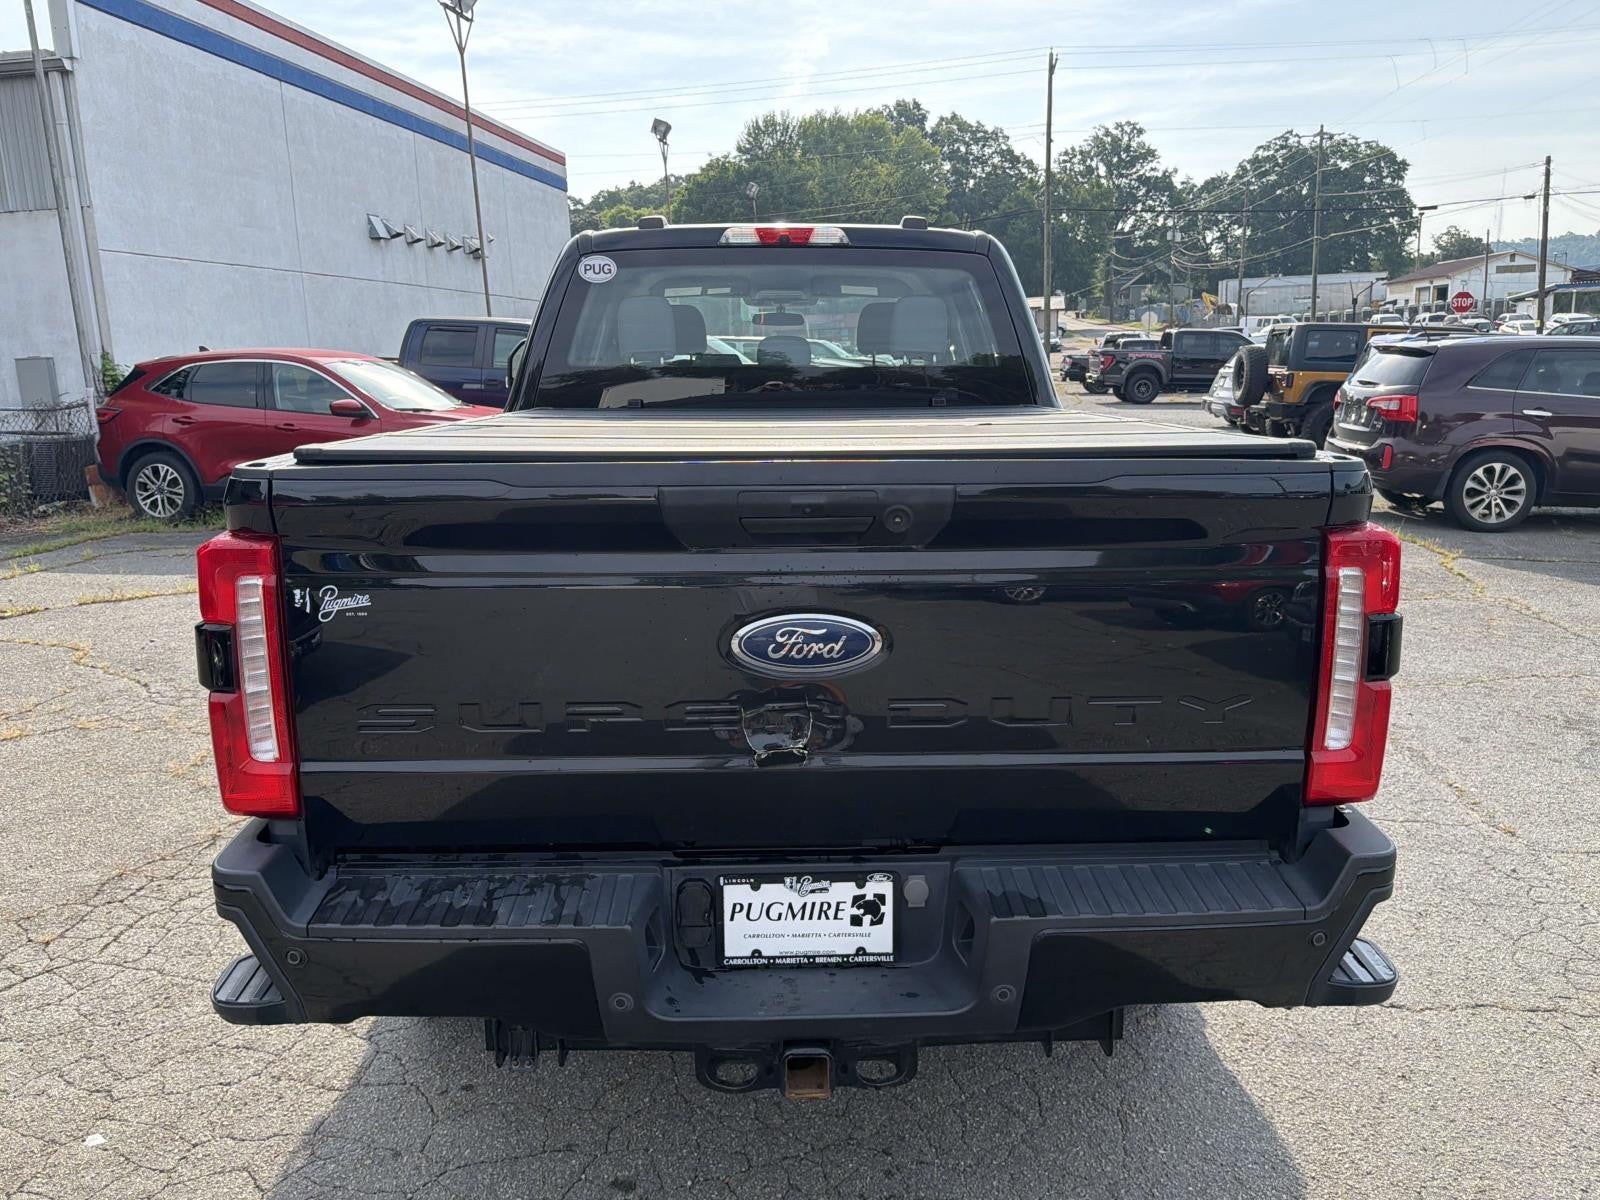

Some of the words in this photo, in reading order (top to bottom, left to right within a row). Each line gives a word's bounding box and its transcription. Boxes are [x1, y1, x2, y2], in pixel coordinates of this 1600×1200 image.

[583, 263, 612, 275] PUG
[1452, 297, 1473, 307] STOP
[318, 585, 371, 622] Pugmire
[767, 627, 847, 659] Ford
[887, 697, 1254, 727] DUTY
[729, 901, 847, 922] PUGMIRE
